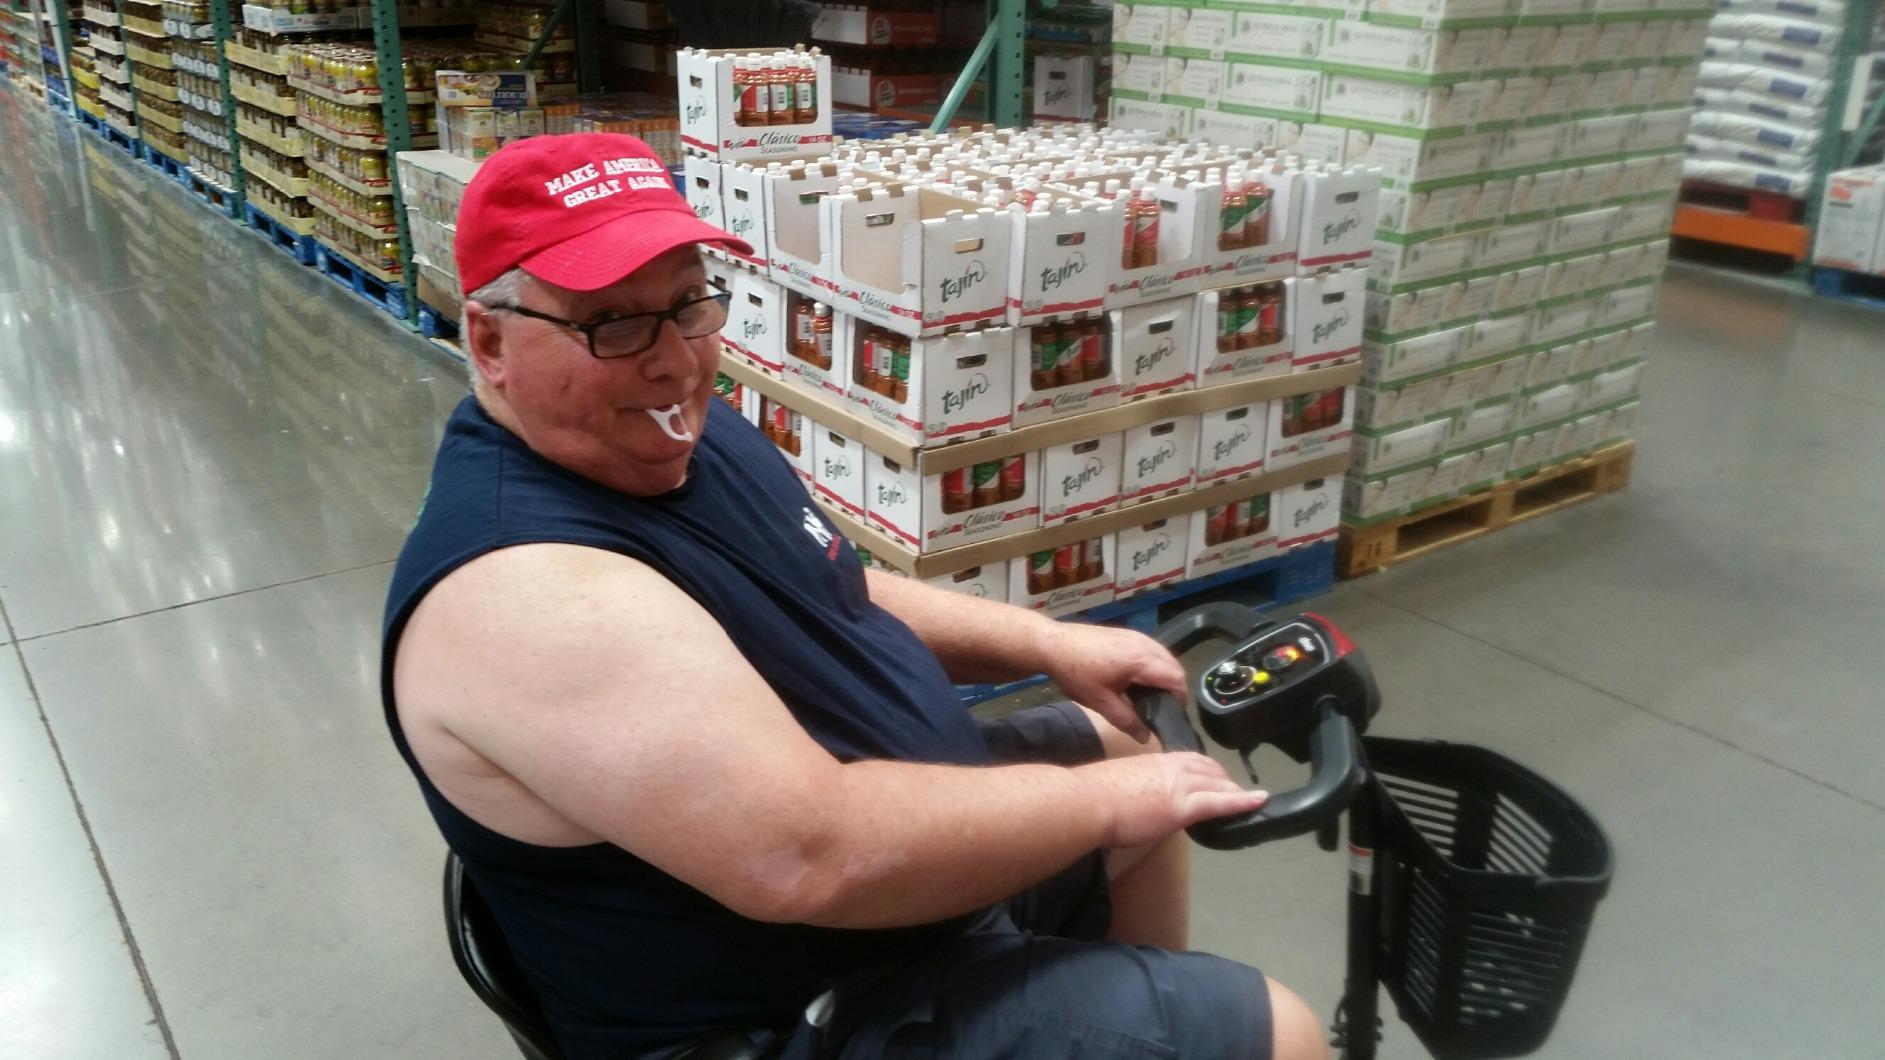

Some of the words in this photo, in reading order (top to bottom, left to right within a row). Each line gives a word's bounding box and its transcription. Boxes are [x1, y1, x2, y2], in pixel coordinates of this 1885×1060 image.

[544, 163, 600, 195] MAKE
[603, 157, 664, 175] AMERICA
[564, 179, 622, 208] GREAT
[628, 175, 672, 190] AGAIN
